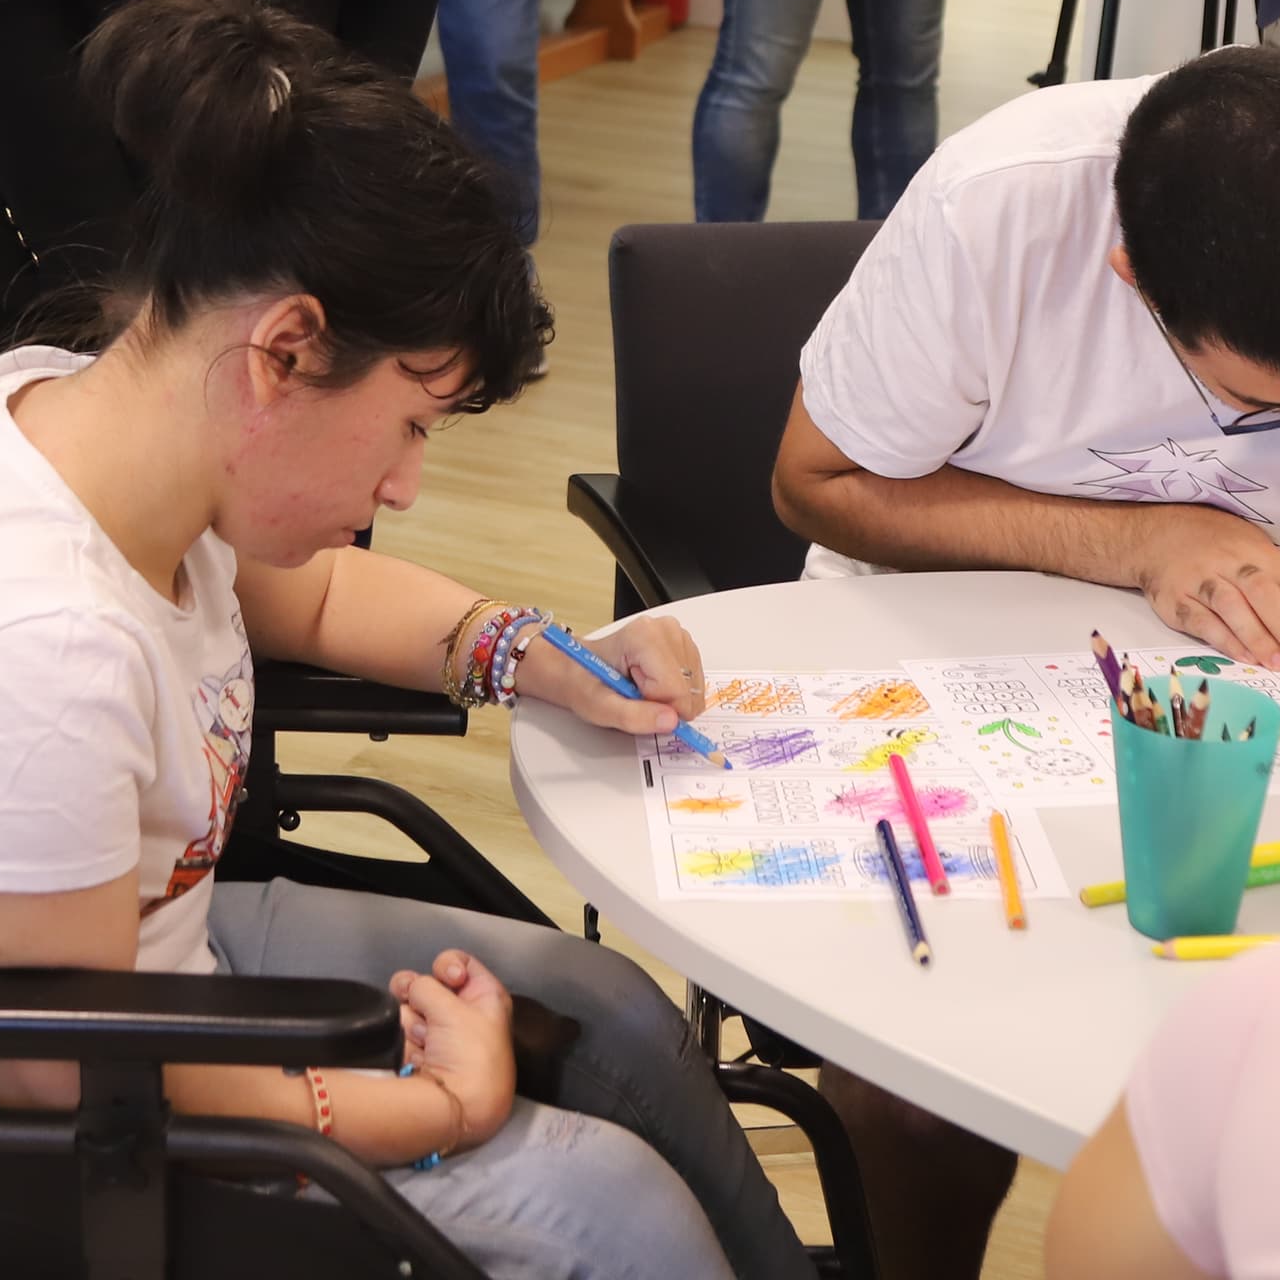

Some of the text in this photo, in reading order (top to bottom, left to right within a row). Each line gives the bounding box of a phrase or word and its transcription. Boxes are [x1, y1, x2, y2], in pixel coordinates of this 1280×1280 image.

[773, 676, 807, 716] WISHES
[943, 680, 1026, 692] BREAK
[953, 690, 1034, 704] DON'T
[963, 702, 1040, 715] BEND
[748, 778, 785, 825] ANYWAY
[781, 779, 819, 824] BLOOM
